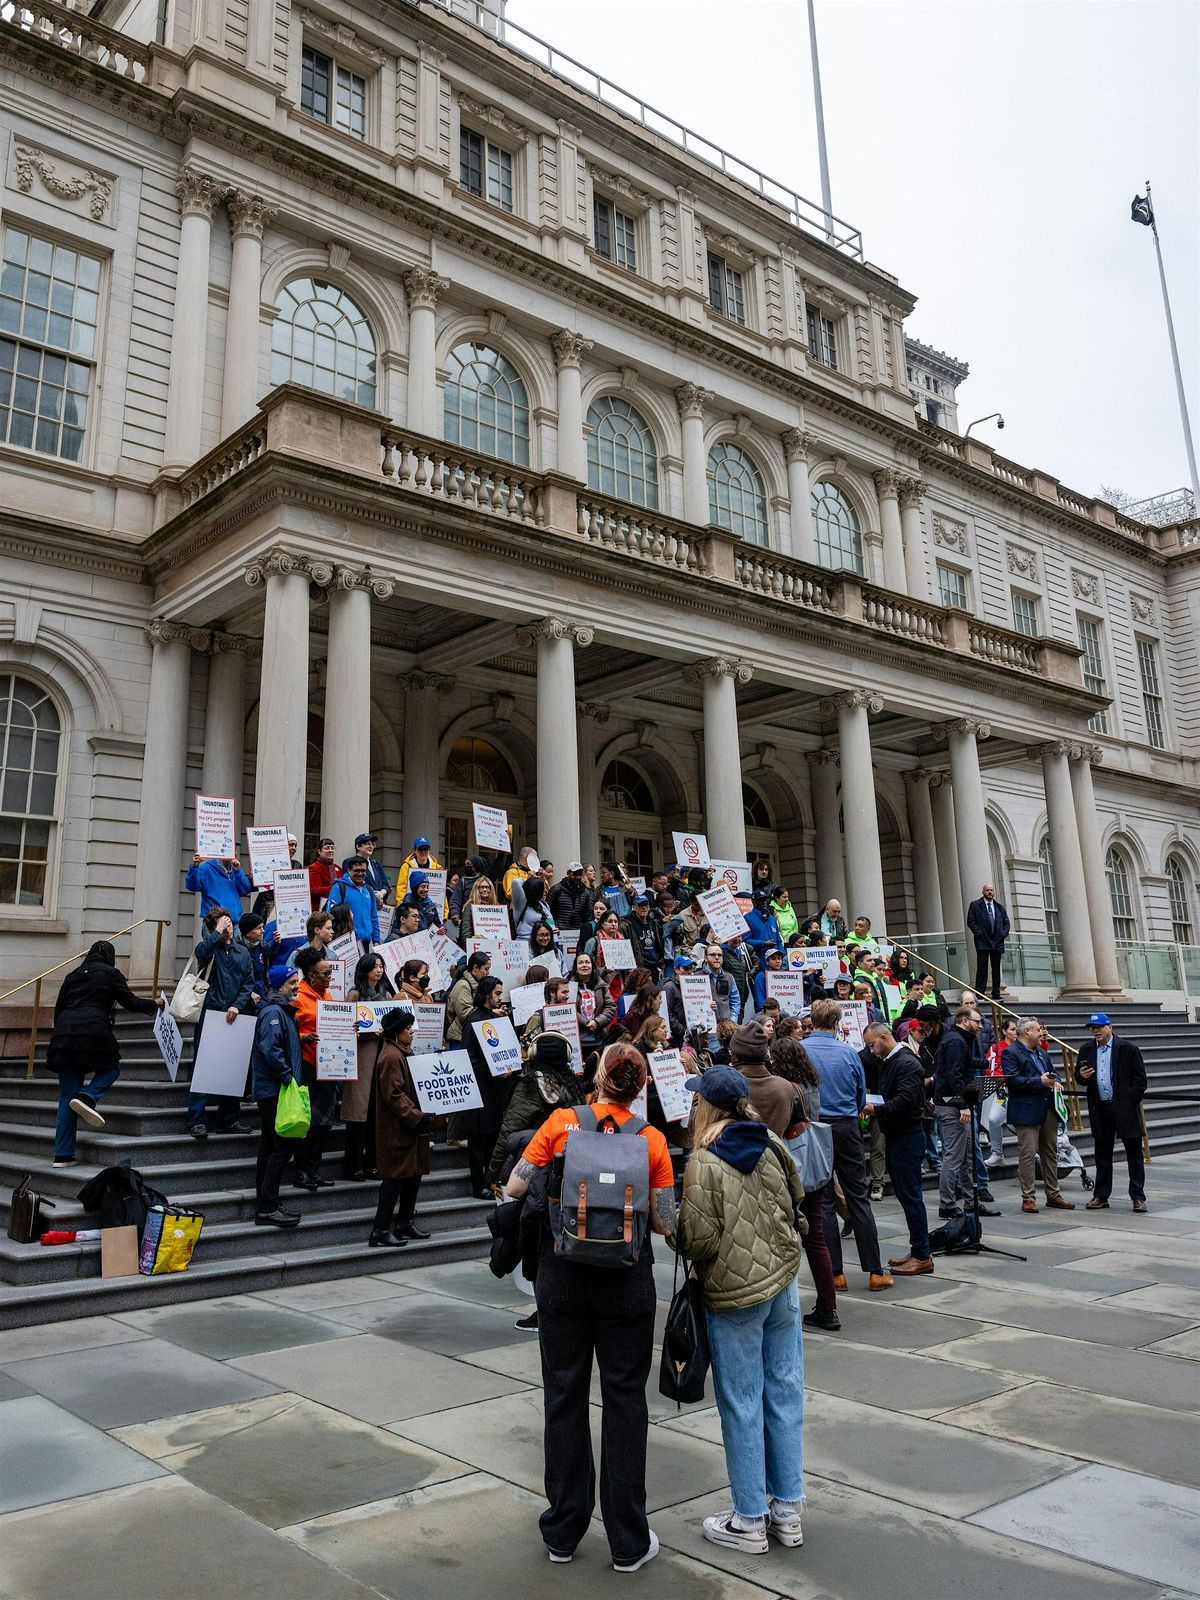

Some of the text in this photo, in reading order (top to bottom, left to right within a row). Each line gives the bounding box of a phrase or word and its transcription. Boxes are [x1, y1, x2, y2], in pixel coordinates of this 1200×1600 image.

[323, 1004, 352, 1012] ROUNDTABLE
[374, 1006, 396, 1016] UNITE
[548, 1008, 572, 1016] ROUNDTABLE
[491, 1048, 519, 1062] UNITED WAY
[653, 1053, 677, 1062] ROUNDTABLE
[417, 1074, 474, 1091] FOOD BANK
[427, 1086, 470, 1101] FOR NYC
[564, 1123, 581, 1131] TAK
